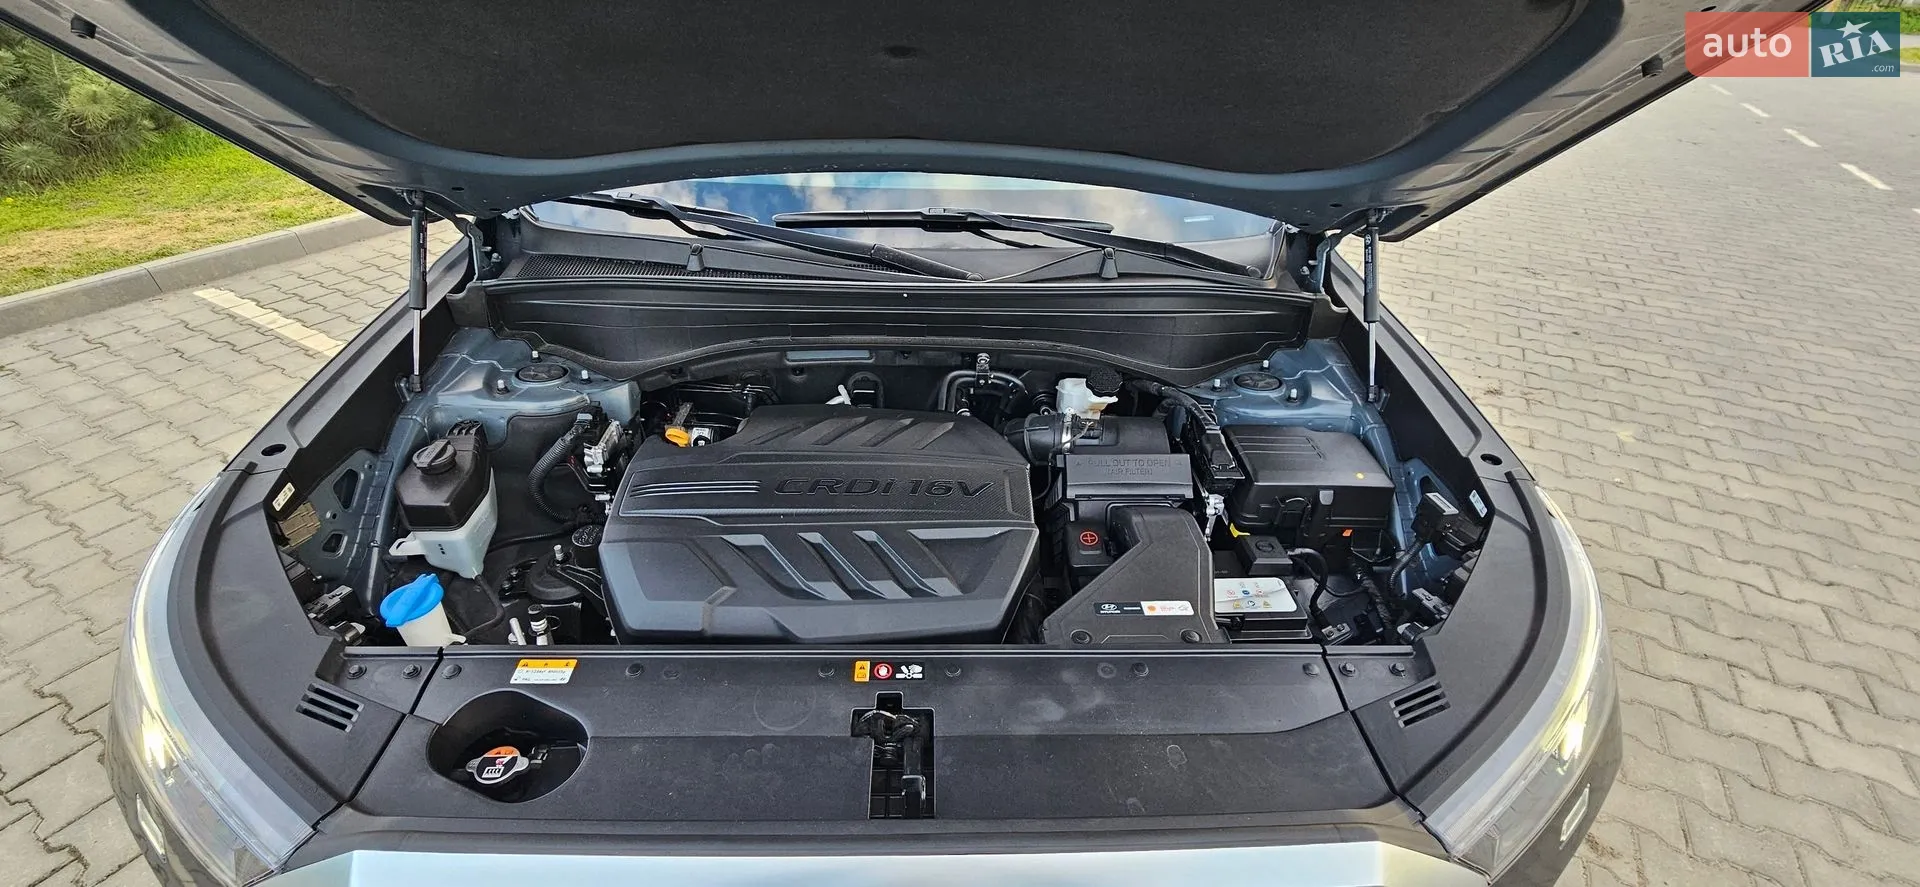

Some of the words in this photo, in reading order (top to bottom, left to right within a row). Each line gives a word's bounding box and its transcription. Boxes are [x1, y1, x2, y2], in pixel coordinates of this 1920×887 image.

[1088, 459, 1111, 467] PULL
[1112, 459, 1131, 467] OUT
[1134, 459, 1145, 467] TO
[1147, 459, 1171, 467] OPEN
[909, 479, 995, 498] 16V
